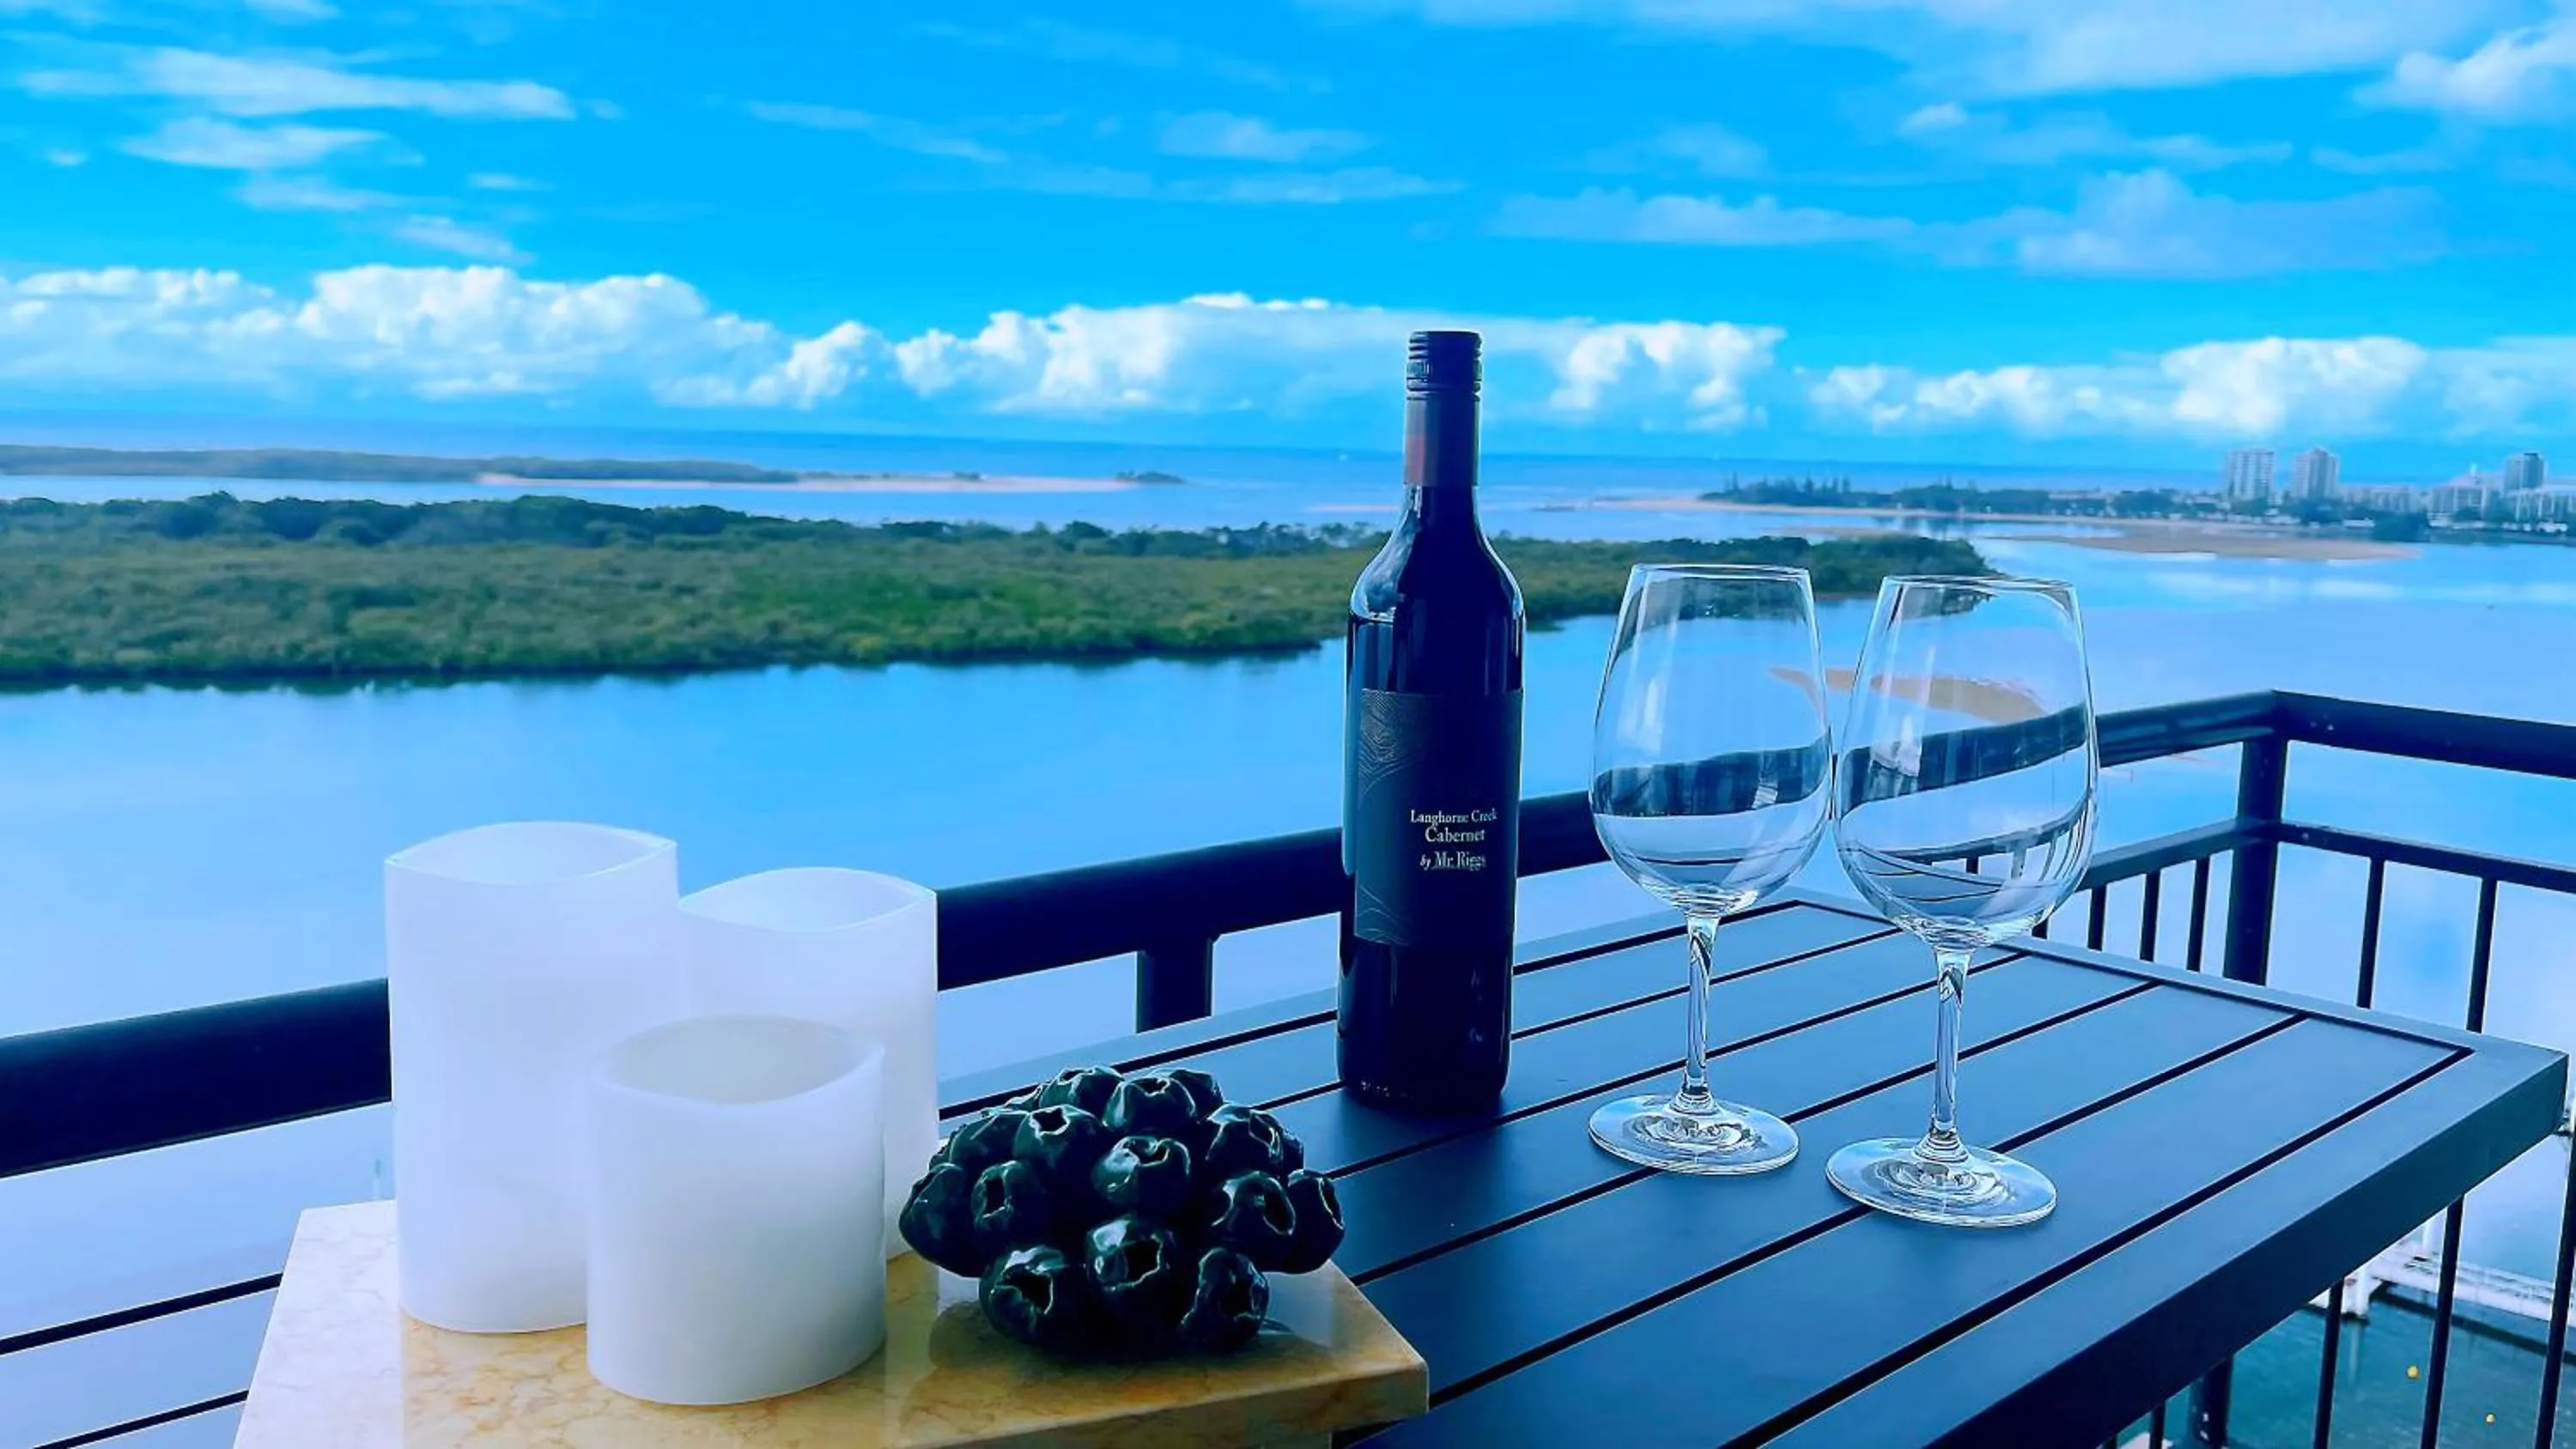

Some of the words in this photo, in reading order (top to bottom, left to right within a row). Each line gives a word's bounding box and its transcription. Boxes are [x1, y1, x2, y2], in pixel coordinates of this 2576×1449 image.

[1410, 809, 1468, 827] Langhorne
[1471, 808, 1498, 822] Creek
[1425, 827, 1485, 842] Cabernet
[1419, 854, 1431, 870] by
[1456, 851, 1486, 870] Riggs
